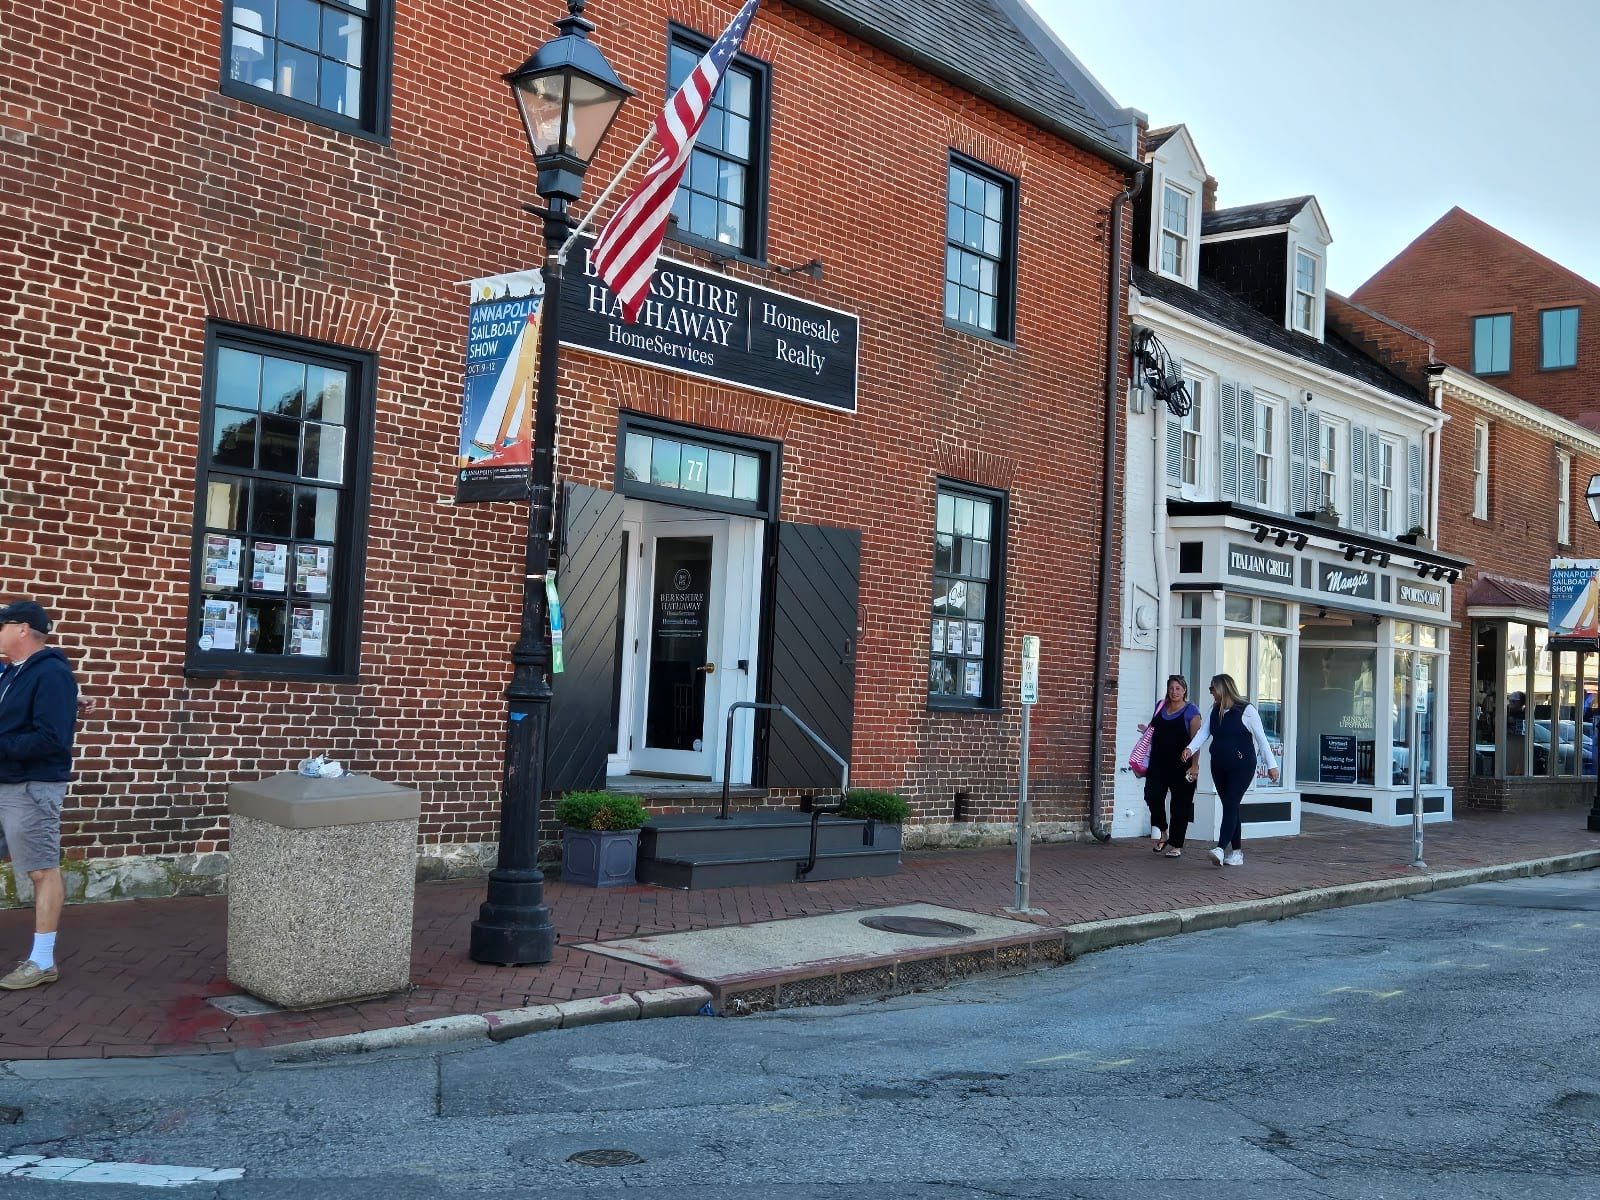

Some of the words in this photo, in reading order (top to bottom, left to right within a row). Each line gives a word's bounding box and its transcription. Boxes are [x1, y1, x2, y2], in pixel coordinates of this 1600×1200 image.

[582, 247, 739, 318] BSHIRE
[471, 299, 540, 324] ANNAPOLIS
[587, 283, 733, 347] HAHAWAY
[762, 302, 840, 344] Homesale
[470, 320, 521, 341] SAILBOAT
[469, 340, 499, 359] SHOW
[608, 323, 714, 366] HomeServices
[775, 338, 826, 376] Realty
[467, 364, 480, 374] OCT
[687, 459, 703, 482] 77
[1231, 552, 1265, 574] ITALIAN
[1266, 559, 1292, 578] GRILL
[1552, 571, 1597, 579] ANNAPOLIS
[1327, 570, 1368, 595] Mangia
[1551, 585, 1574, 593] SHOW
[1552, 578, 1587, 586] SAILBOAT
[660, 593, 704, 602] BERKSHIRE
[661, 601, 701, 610] HATHAWAY
